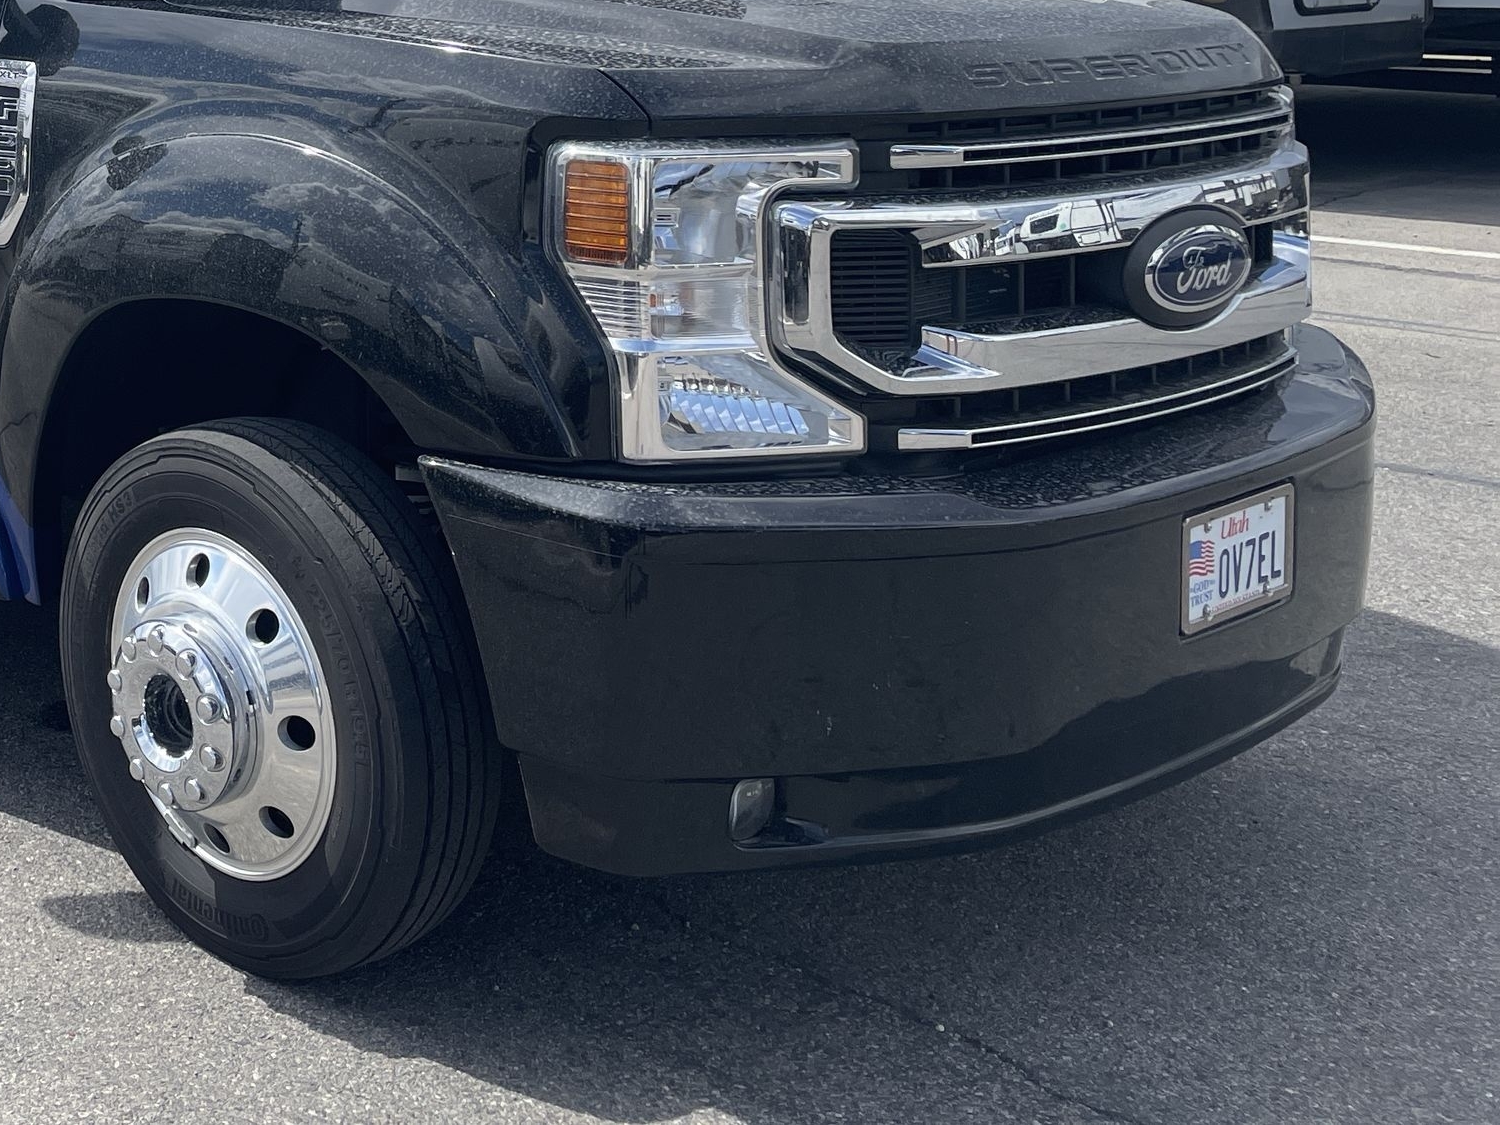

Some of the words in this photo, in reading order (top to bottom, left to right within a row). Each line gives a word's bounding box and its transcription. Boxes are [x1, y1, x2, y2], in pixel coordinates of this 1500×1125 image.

[0, 70, 20, 79] XLT
[964, 54, 1155, 89] SUPER
[1150, 43, 1250, 75] DUTY
[1176, 244, 1233, 294] Ford
[1221, 510, 1250, 539] Utah
[1191, 589, 1214, 607] TRUST
